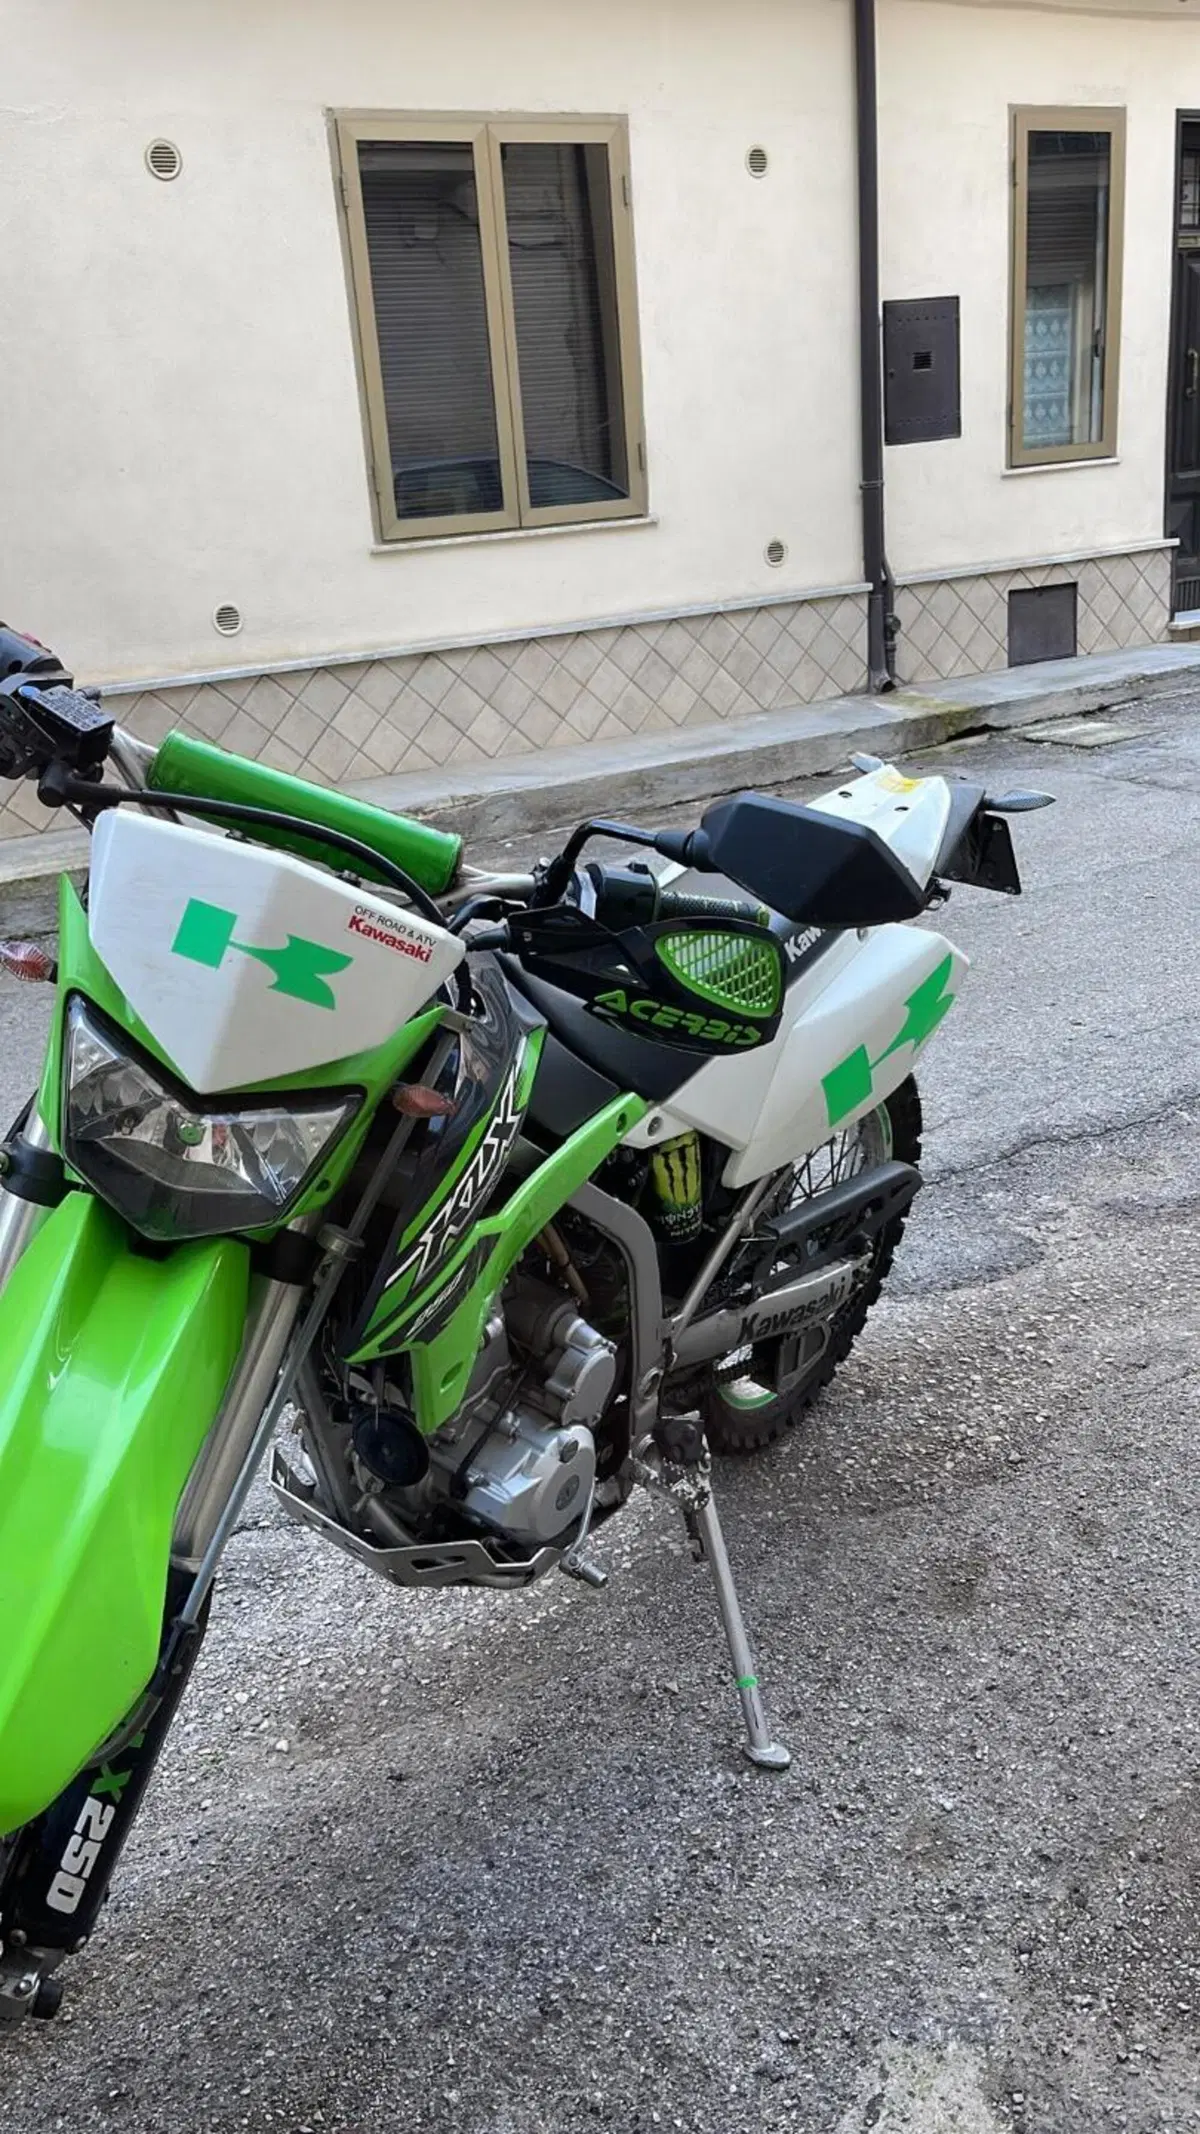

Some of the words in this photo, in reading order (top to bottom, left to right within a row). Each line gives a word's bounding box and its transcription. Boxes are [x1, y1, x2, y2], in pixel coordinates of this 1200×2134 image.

[347, 914, 433, 963] Kawasaki
[354, 905, 376, 919] OFF
[376, 915, 406, 934] ROAD
[406, 929, 415, 938] &
[415, 934, 437, 947] ATV
[784, 926, 826, 963] Kaw
[736, 1275, 846, 1345] Kawasaki
